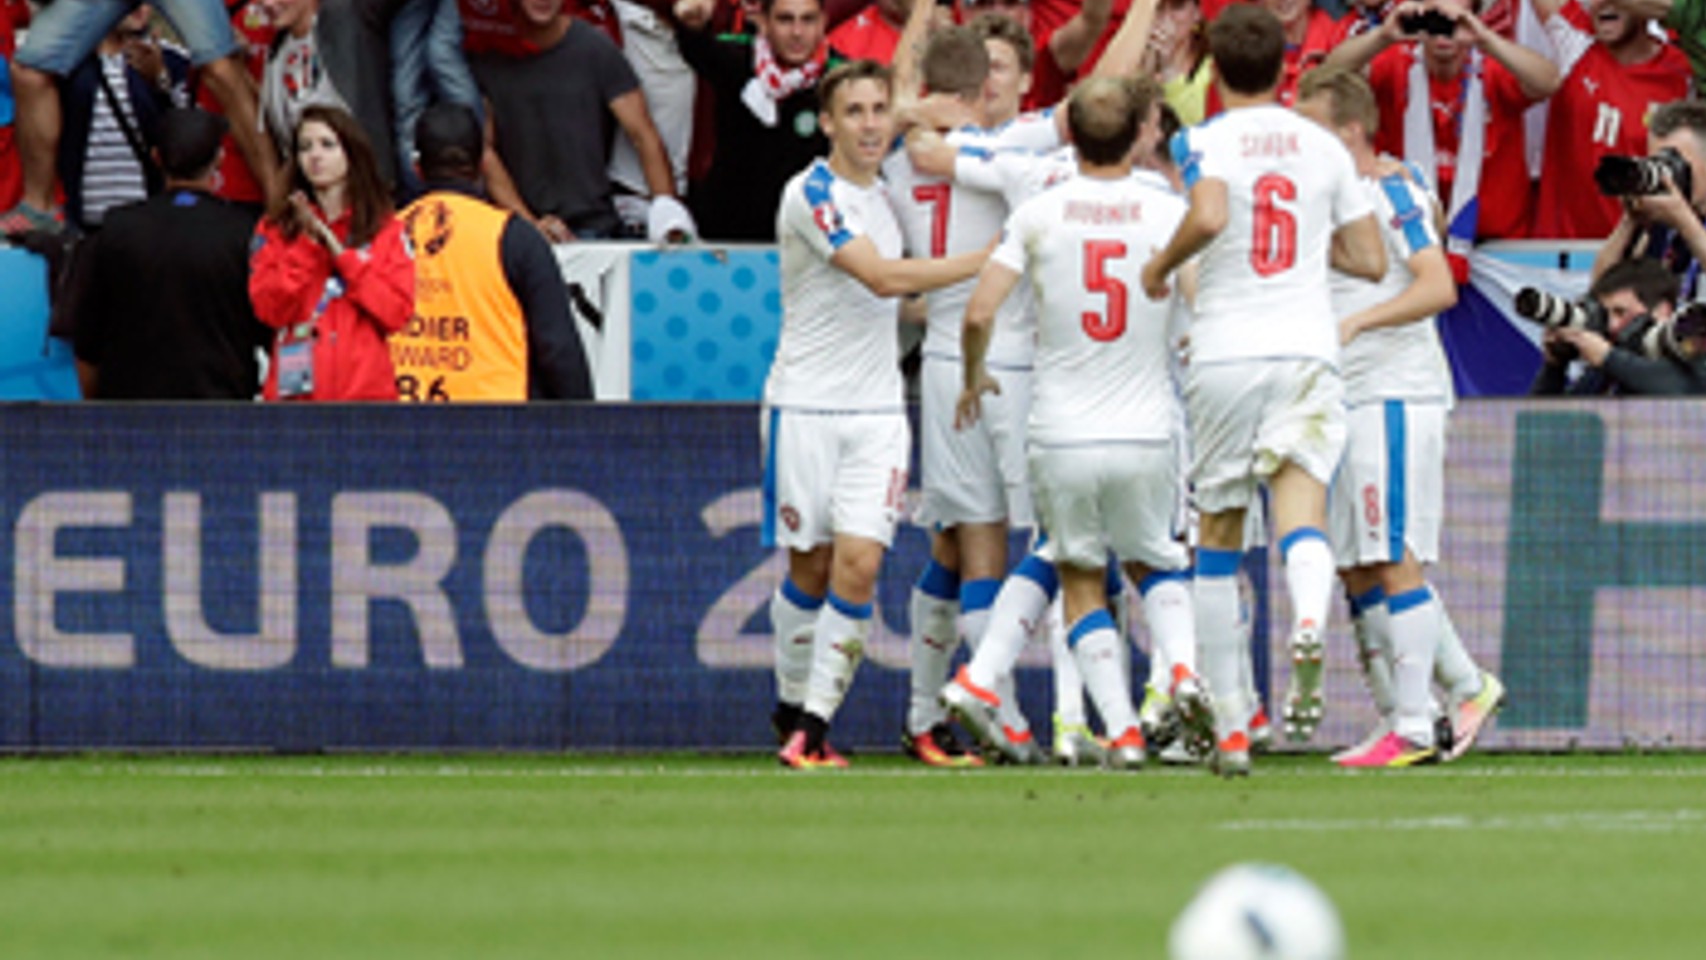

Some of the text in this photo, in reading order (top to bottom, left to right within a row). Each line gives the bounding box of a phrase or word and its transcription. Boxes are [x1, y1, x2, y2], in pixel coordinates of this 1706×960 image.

[912, 183, 952, 258] 7
[1250, 172, 1298, 278] 6
[1081, 240, 1128, 342] 5
[13, 488, 630, 672] EURO
